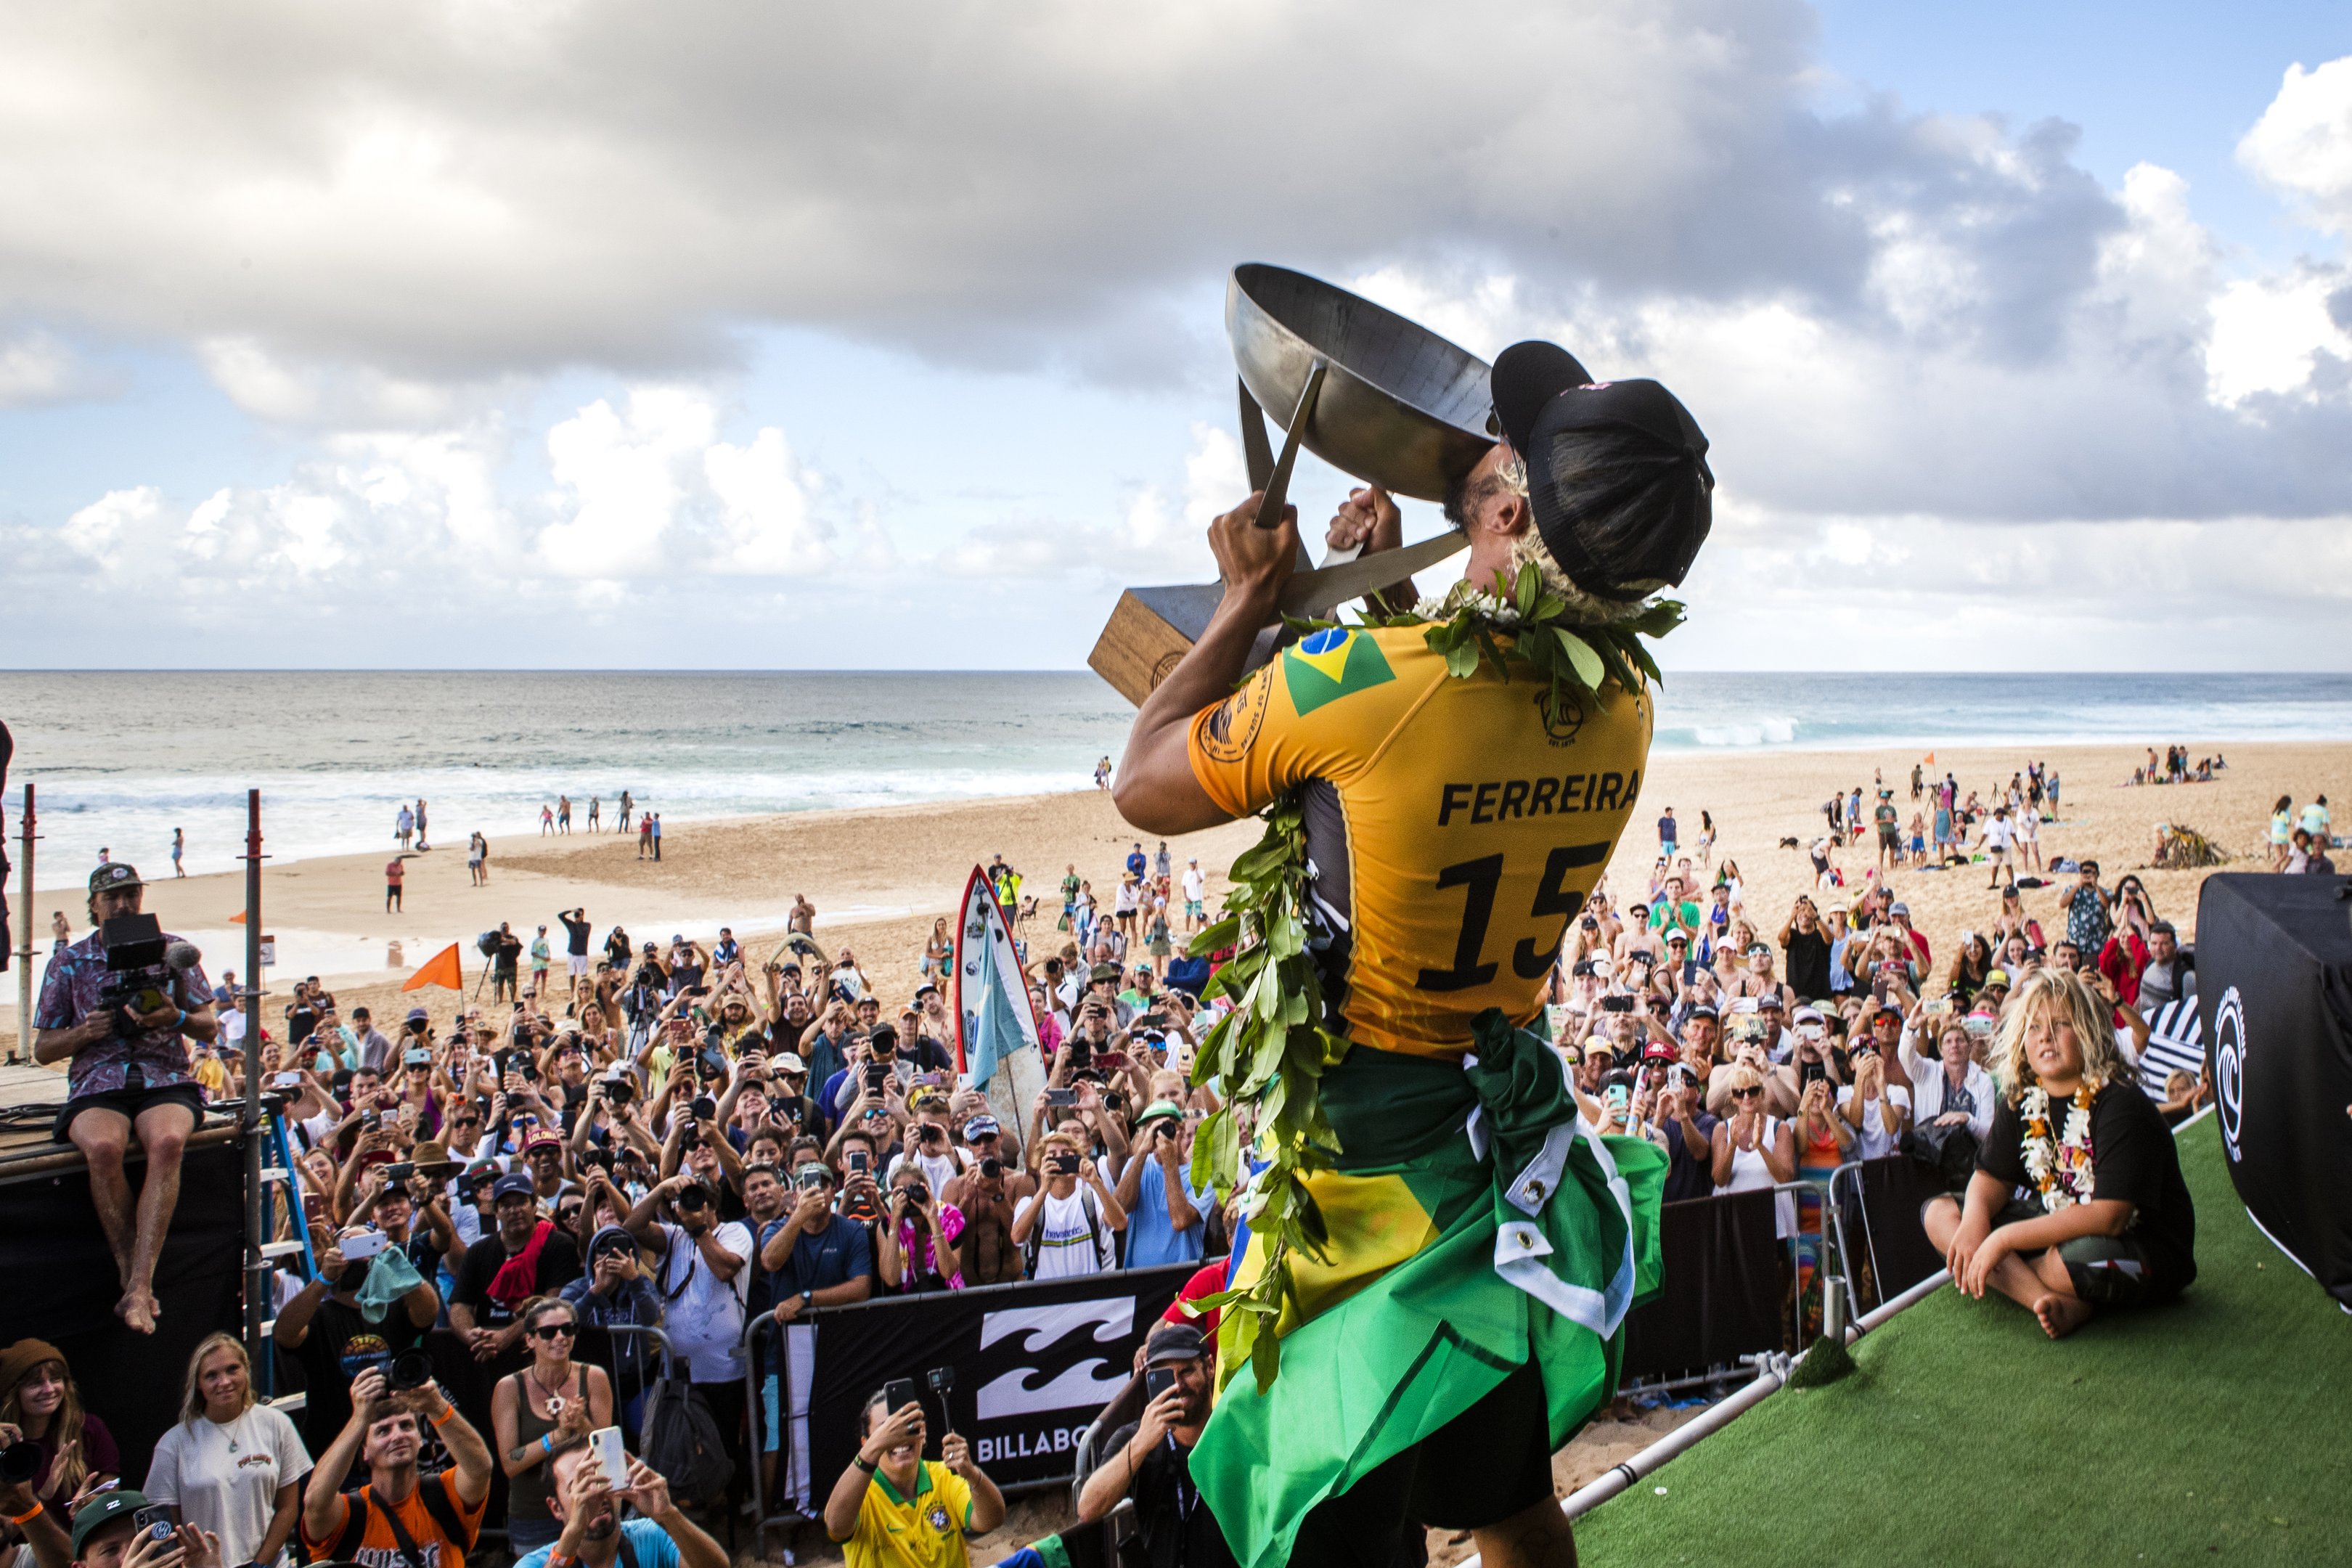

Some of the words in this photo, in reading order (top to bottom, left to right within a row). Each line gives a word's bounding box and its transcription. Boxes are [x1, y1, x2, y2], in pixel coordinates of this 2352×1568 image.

[1240, 712, 1260, 750] SURFING
[1437, 769, 1639, 826] FERREIRA
[1418, 840, 1612, 992] 15
[977, 1424, 1090, 1463] BILLABO
